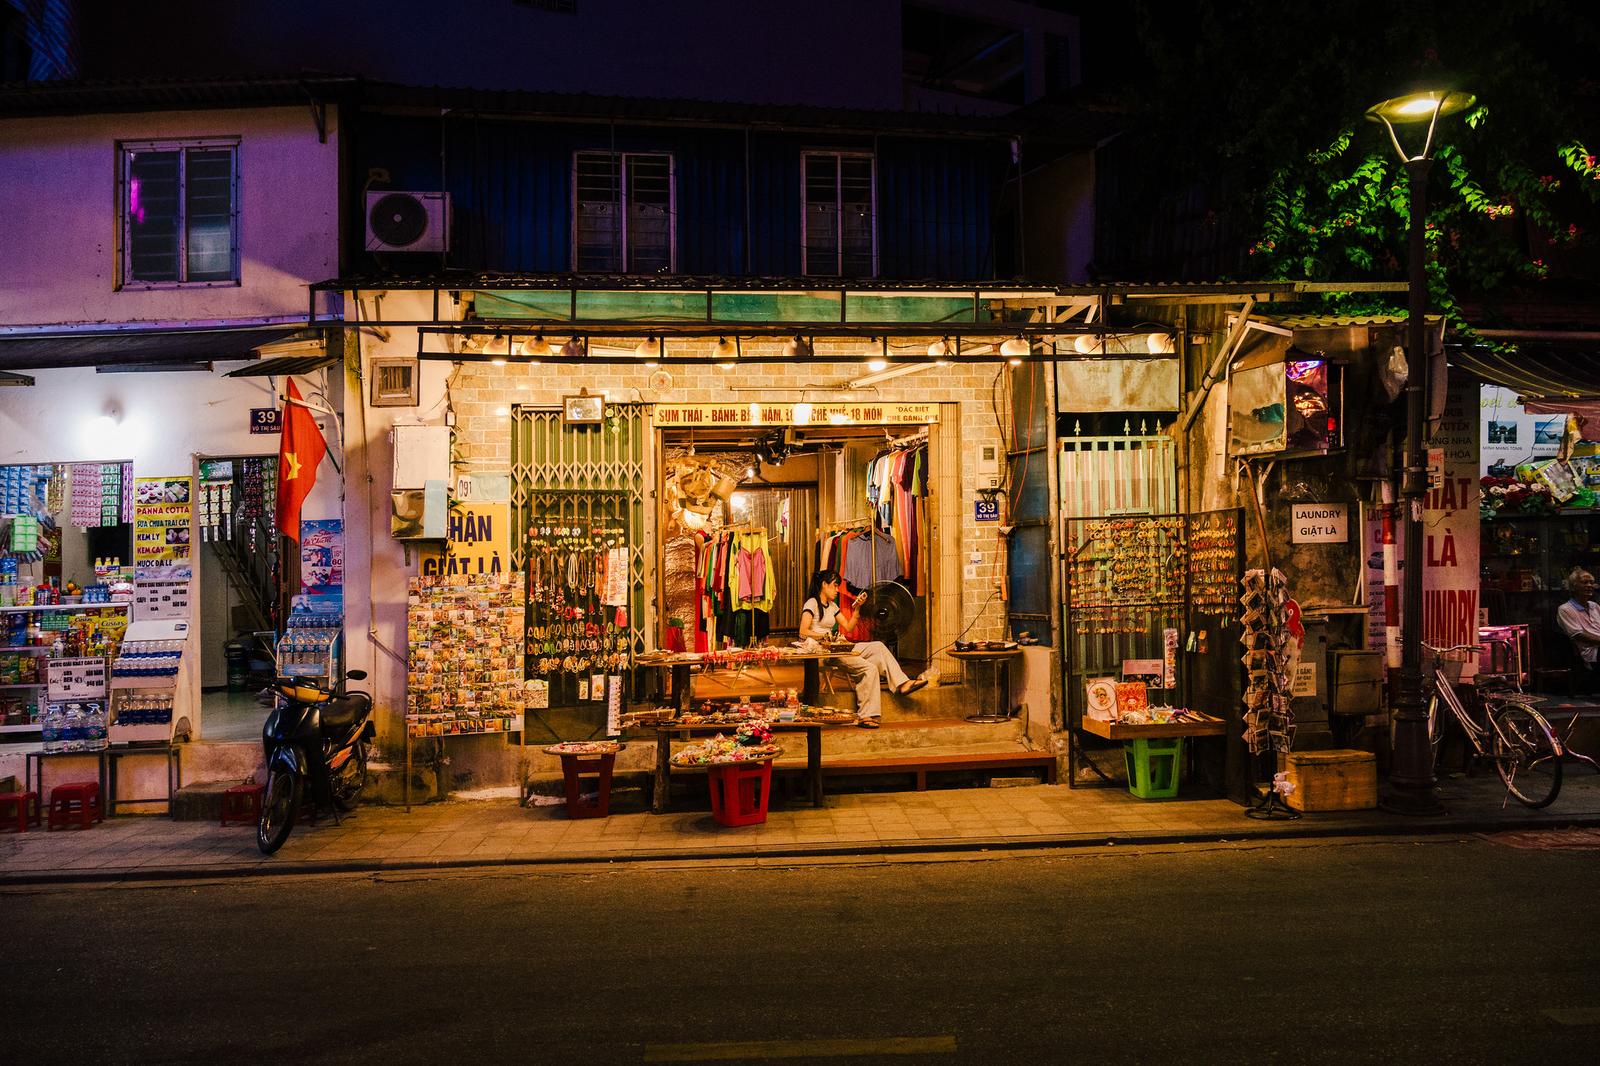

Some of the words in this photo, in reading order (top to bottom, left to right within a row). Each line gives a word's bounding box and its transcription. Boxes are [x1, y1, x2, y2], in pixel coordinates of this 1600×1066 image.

[257, 411, 276, 424] 39
[851, 408, 861, 422] 18
[136, 506, 164, 515] PANNA
[165, 506, 190, 514] COTTA
[979, 502, 995, 513] 39
[1296, 510, 1341, 520] LAUNDRY
[449, 510, 493, 547] HẬN
[1300, 525, 1323, 537] GIẶT
[1325, 524, 1337, 535] LÀ
[1427, 528, 1458, 568] LÀ
[1424, 589, 1477, 664] UNDRY
